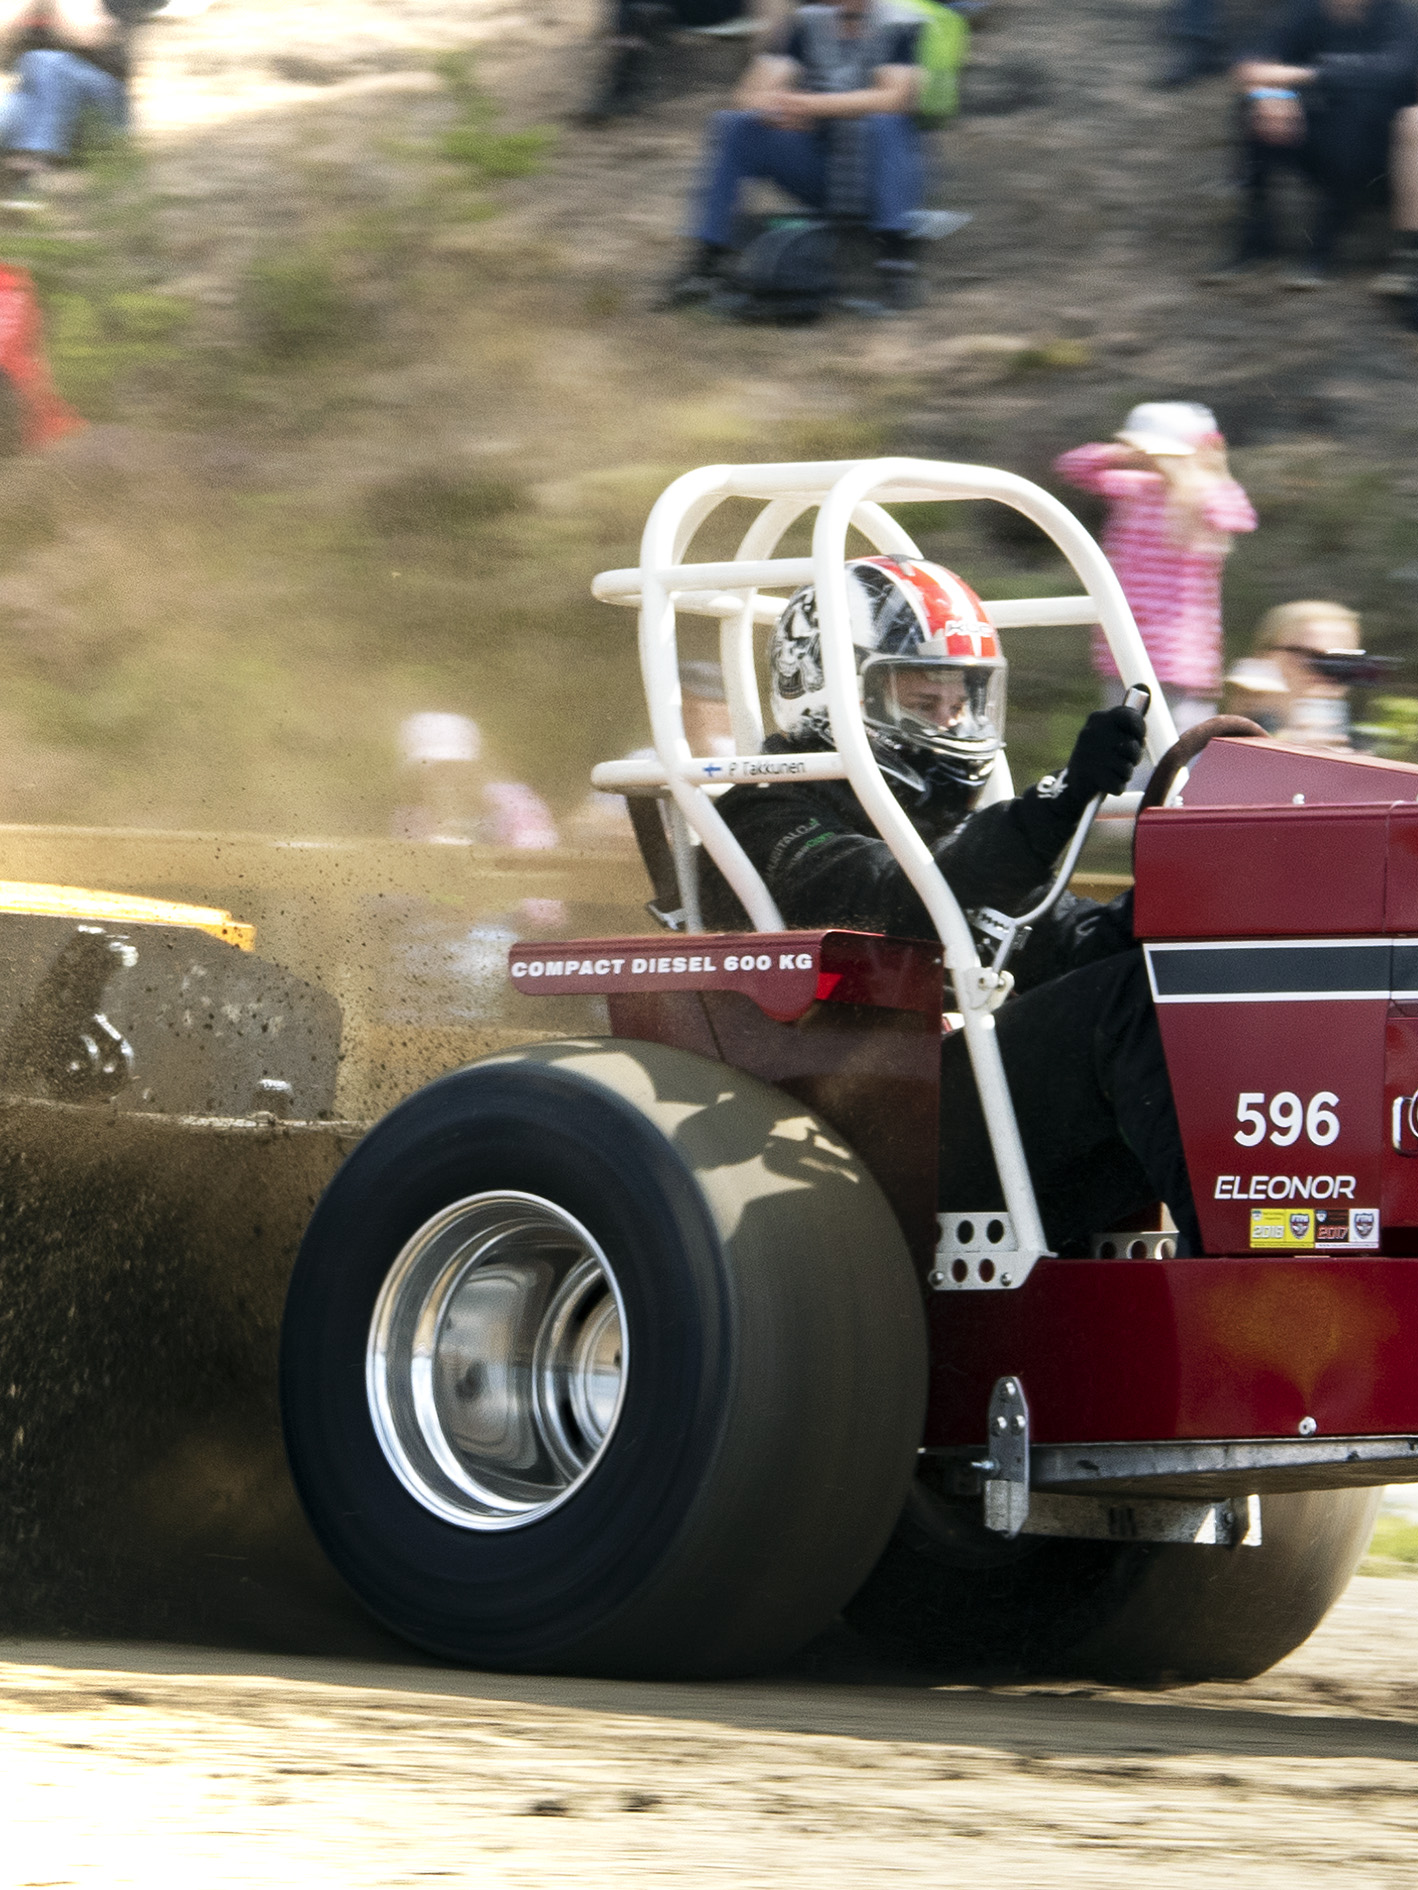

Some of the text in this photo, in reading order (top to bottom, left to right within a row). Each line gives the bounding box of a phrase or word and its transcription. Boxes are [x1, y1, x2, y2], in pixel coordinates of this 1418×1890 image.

[742, 761, 806, 776] Takkunen
[511, 954, 813, 978] COMPACT DIESEL 600 KG
[1234, 1091, 1340, 1147] 596
[1214, 1175, 1357, 1200] ELEONOR
